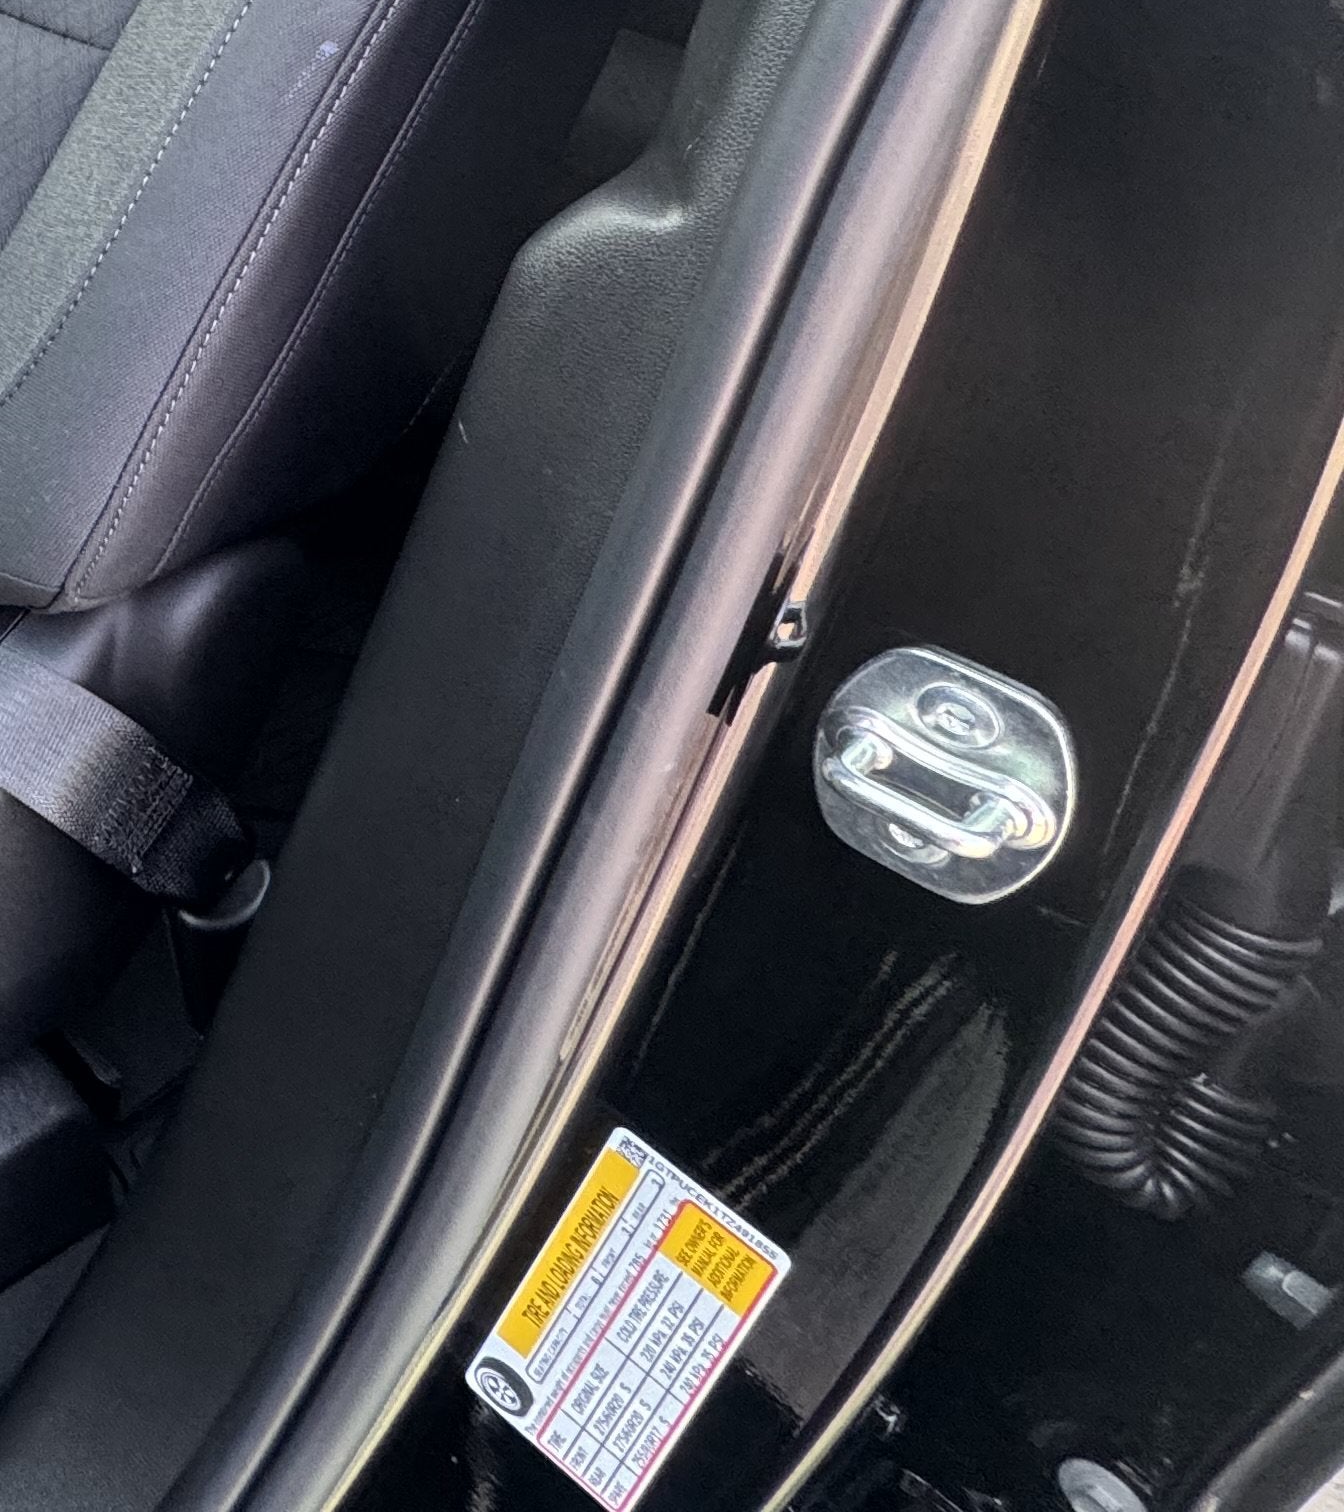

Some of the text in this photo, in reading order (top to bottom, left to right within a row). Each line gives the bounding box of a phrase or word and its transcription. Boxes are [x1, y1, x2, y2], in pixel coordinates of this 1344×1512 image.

[522, 1185, 619, 1328] TIRE AND LOADING INFORMATION
[628, 1252, 646, 1272] 785
[653, 1208, 673, 1232] 1731
[676, 1218, 711, 1265] SEE OWNER'S
[691, 1231, 724, 1276] MANUAL FOR
[707, 1245, 739, 1287] ADDITIONAL
[720, 1253, 756, 1300] INFORMATION
[661, 1315, 674, 1329] 32
[667, 1299, 684, 1318] PSI
[547, 1269, 669, 1451] TIRE ORIGINAL SIZE COLD TIRE PRESSURE
[640, 1343, 656, 1362] 220
[660, 1360, 676, 1378] 240
[681, 1332, 694, 1346] 35
[688, 1316, 705, 1334] PSI
[708, 1332, 726, 1351] PSI
[568, 1445, 588, 1470] FRONT
